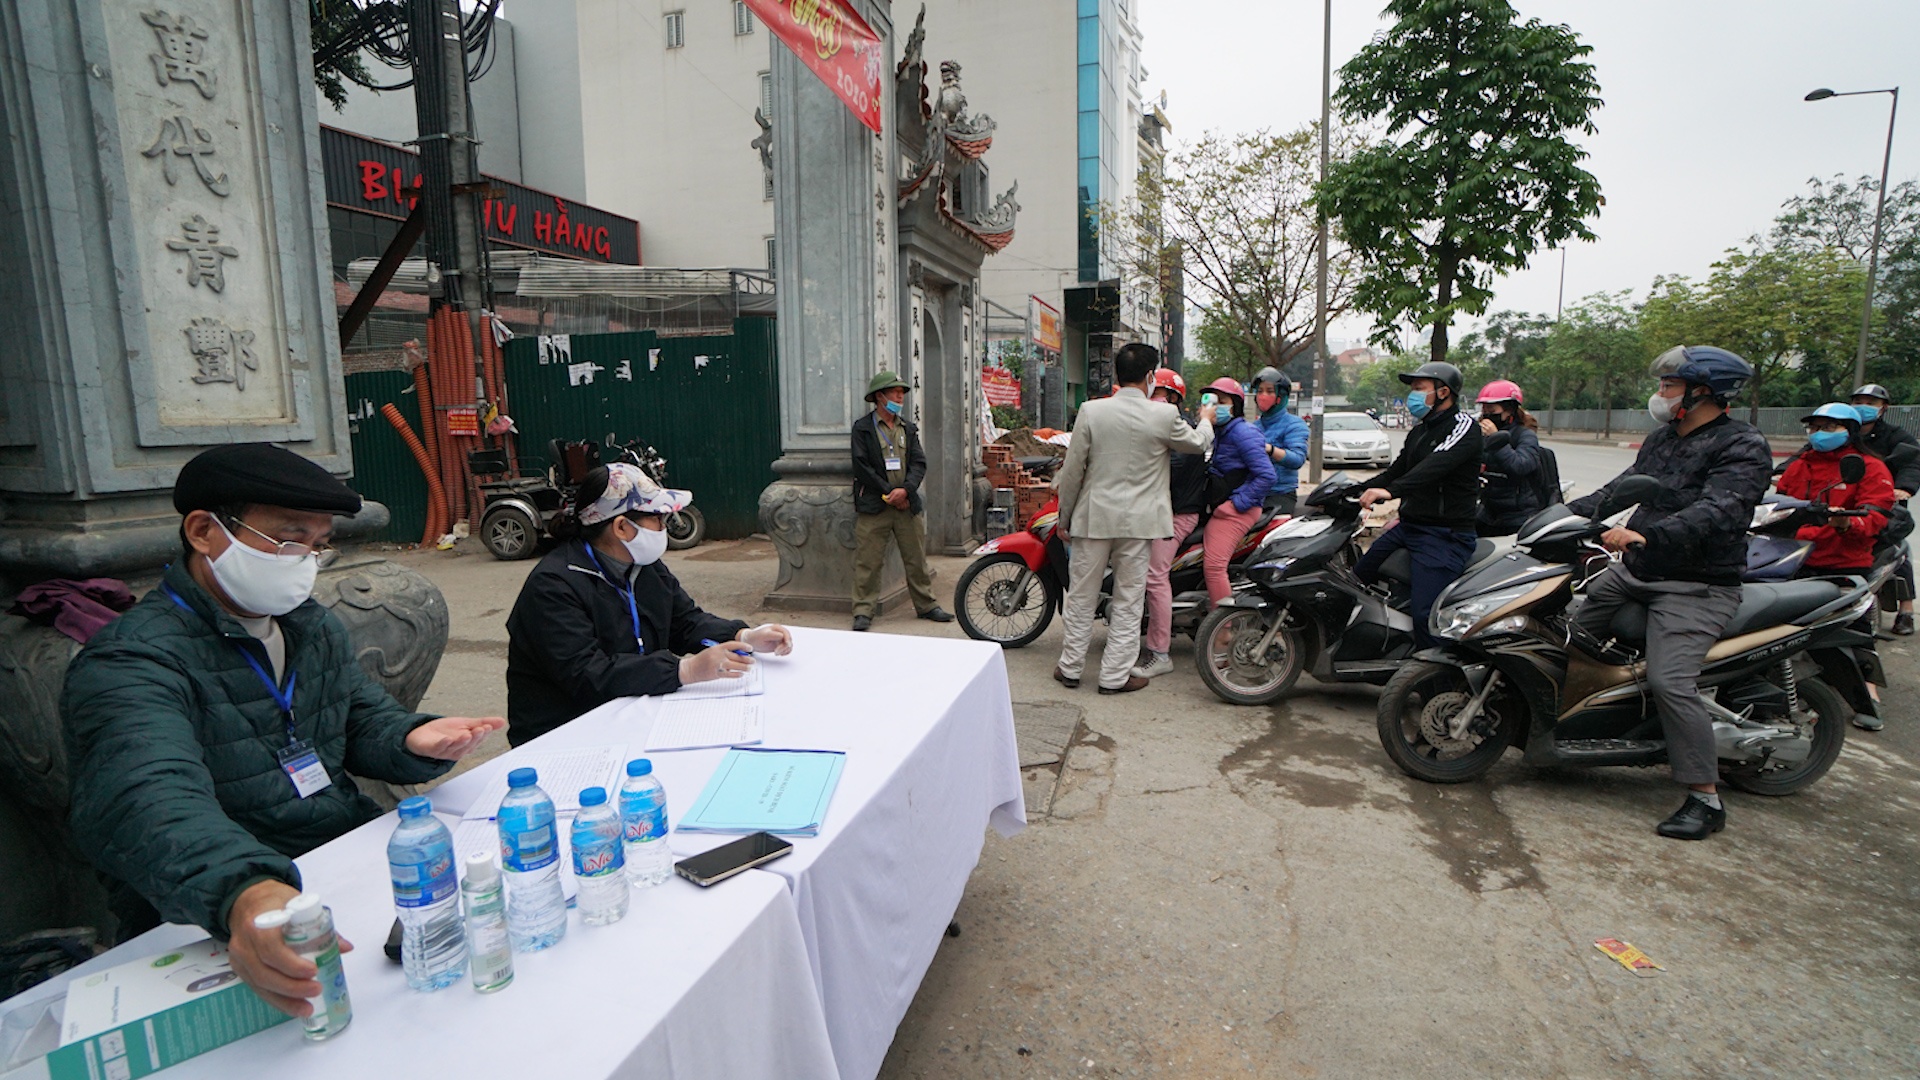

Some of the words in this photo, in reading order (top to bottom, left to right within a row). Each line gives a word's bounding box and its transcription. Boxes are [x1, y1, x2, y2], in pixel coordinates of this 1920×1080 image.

[837, 66, 868, 113] 2020
[534, 196, 611, 260] HẰNG
[1482, 637, 1512, 646] HONDA
[1747, 649, 1769, 661] AIR
[1771, 633, 1812, 654] BLADE
